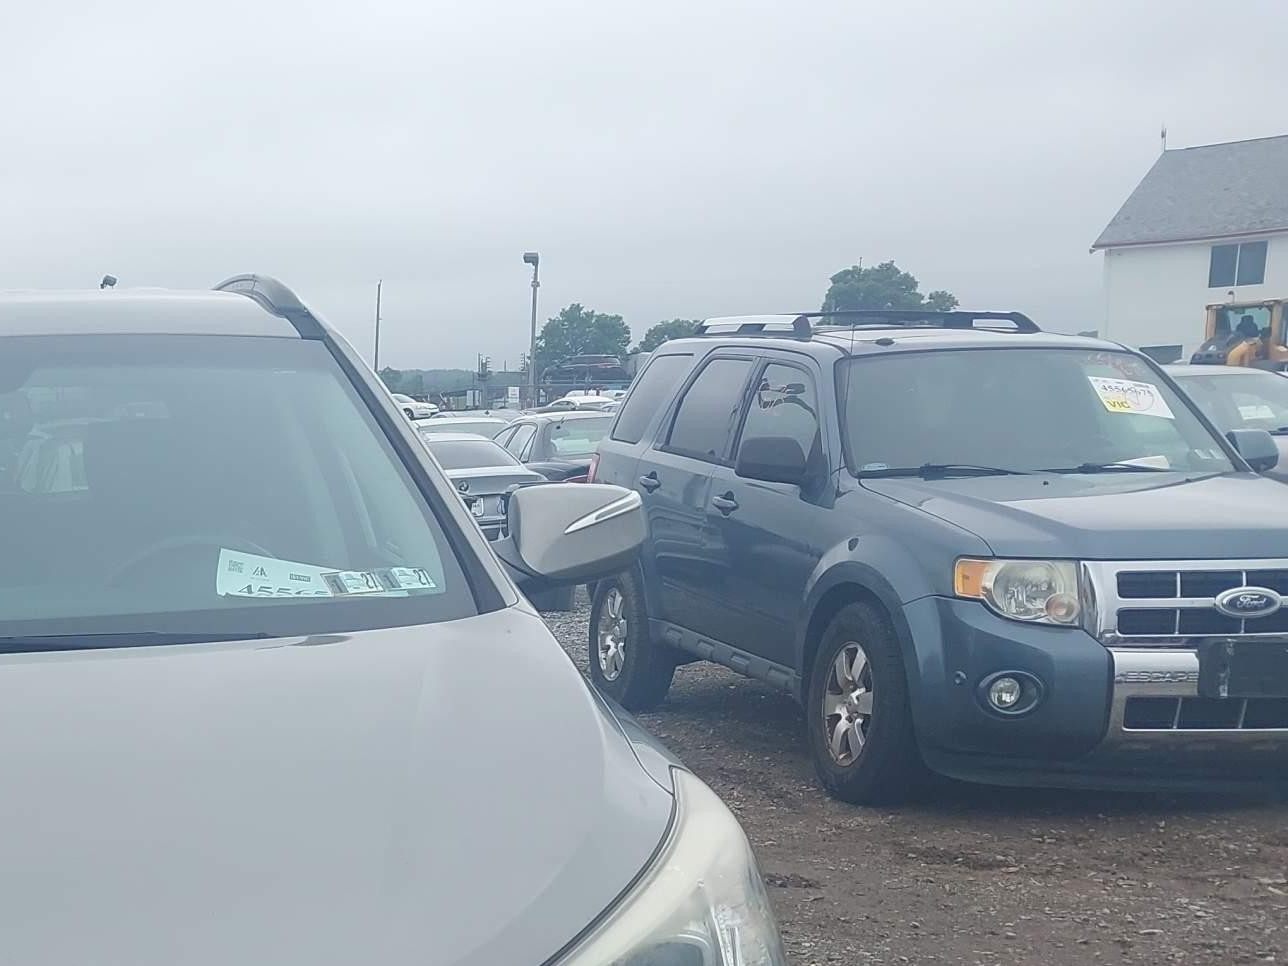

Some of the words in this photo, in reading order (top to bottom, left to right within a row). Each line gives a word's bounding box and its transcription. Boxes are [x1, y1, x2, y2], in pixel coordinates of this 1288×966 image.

[360, 572, 379, 590] 27
[412, 569, 431, 586] 27
[1237, 595, 1267, 608] Ford
[1125, 671, 1199, 683] ESCAPE
